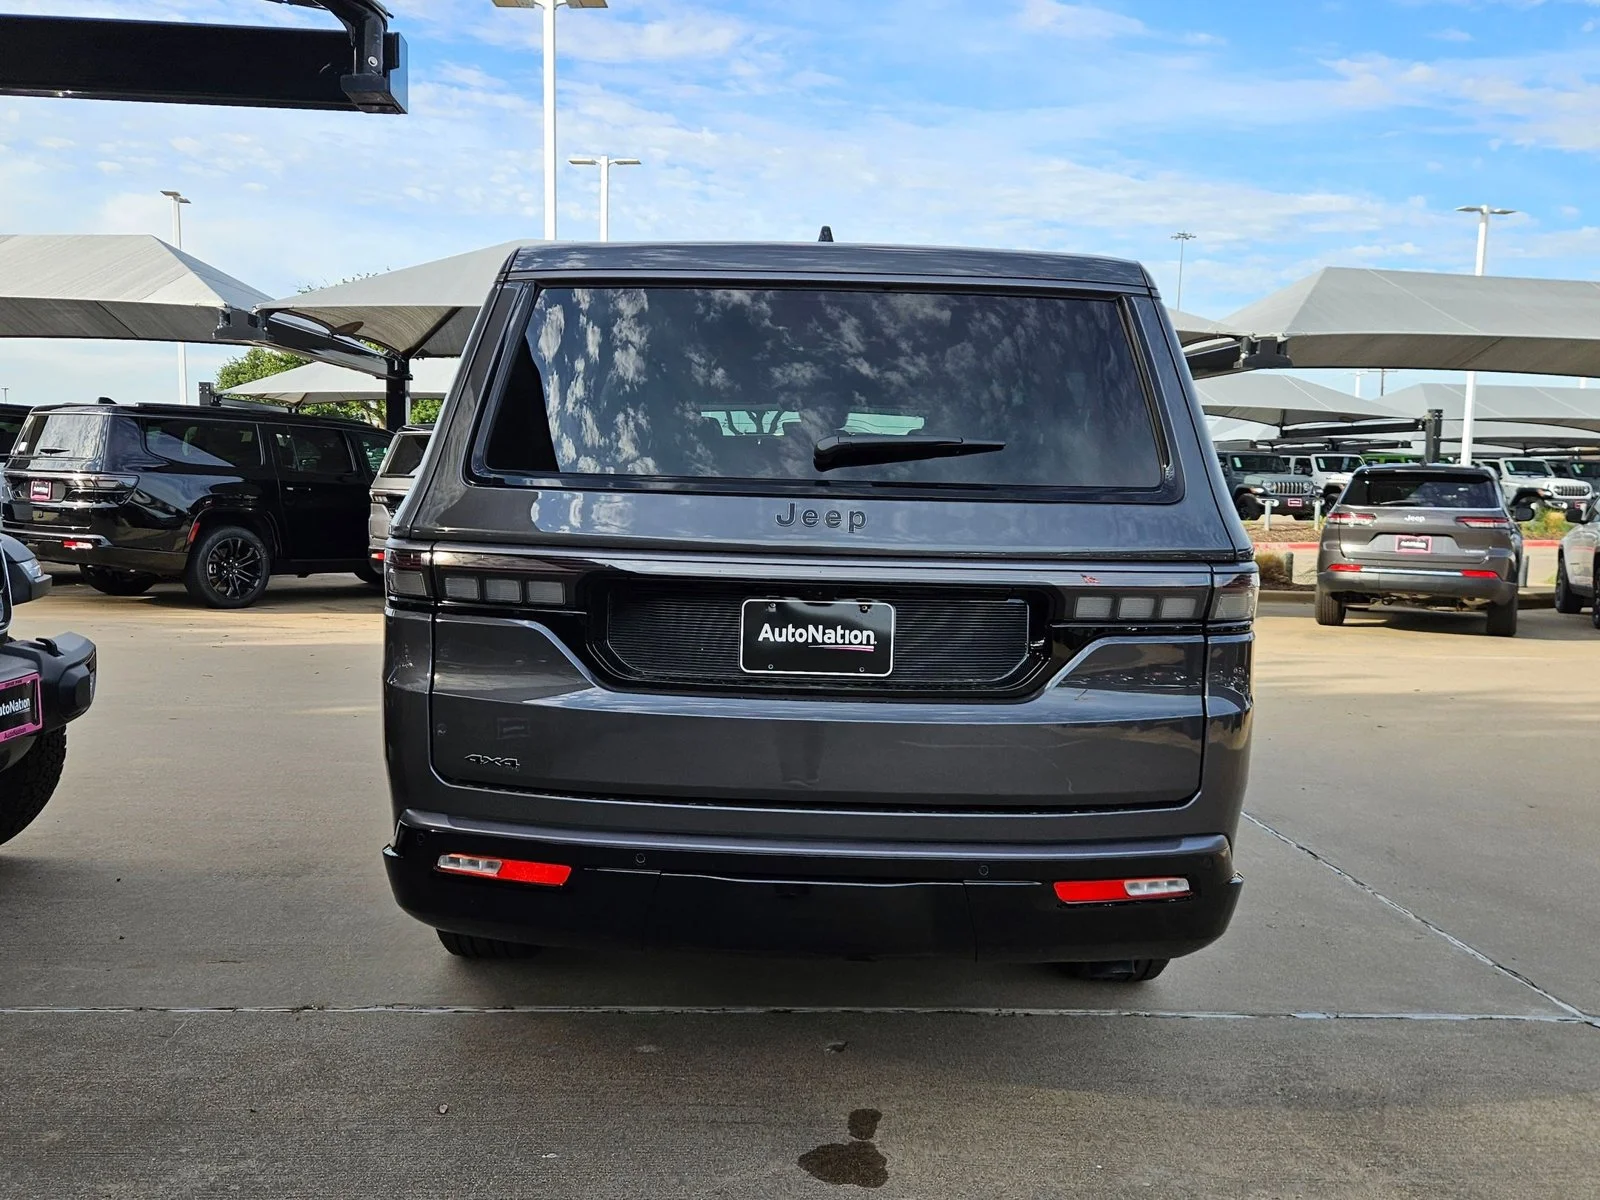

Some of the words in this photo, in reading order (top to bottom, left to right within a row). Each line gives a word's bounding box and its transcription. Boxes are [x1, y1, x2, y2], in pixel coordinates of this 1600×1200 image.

[776, 502, 867, 533] Jeep
[1404, 515, 1425, 523] Jeep
[758, 623, 875, 645] AutoNation
[0, 698, 30, 717] utoNation
